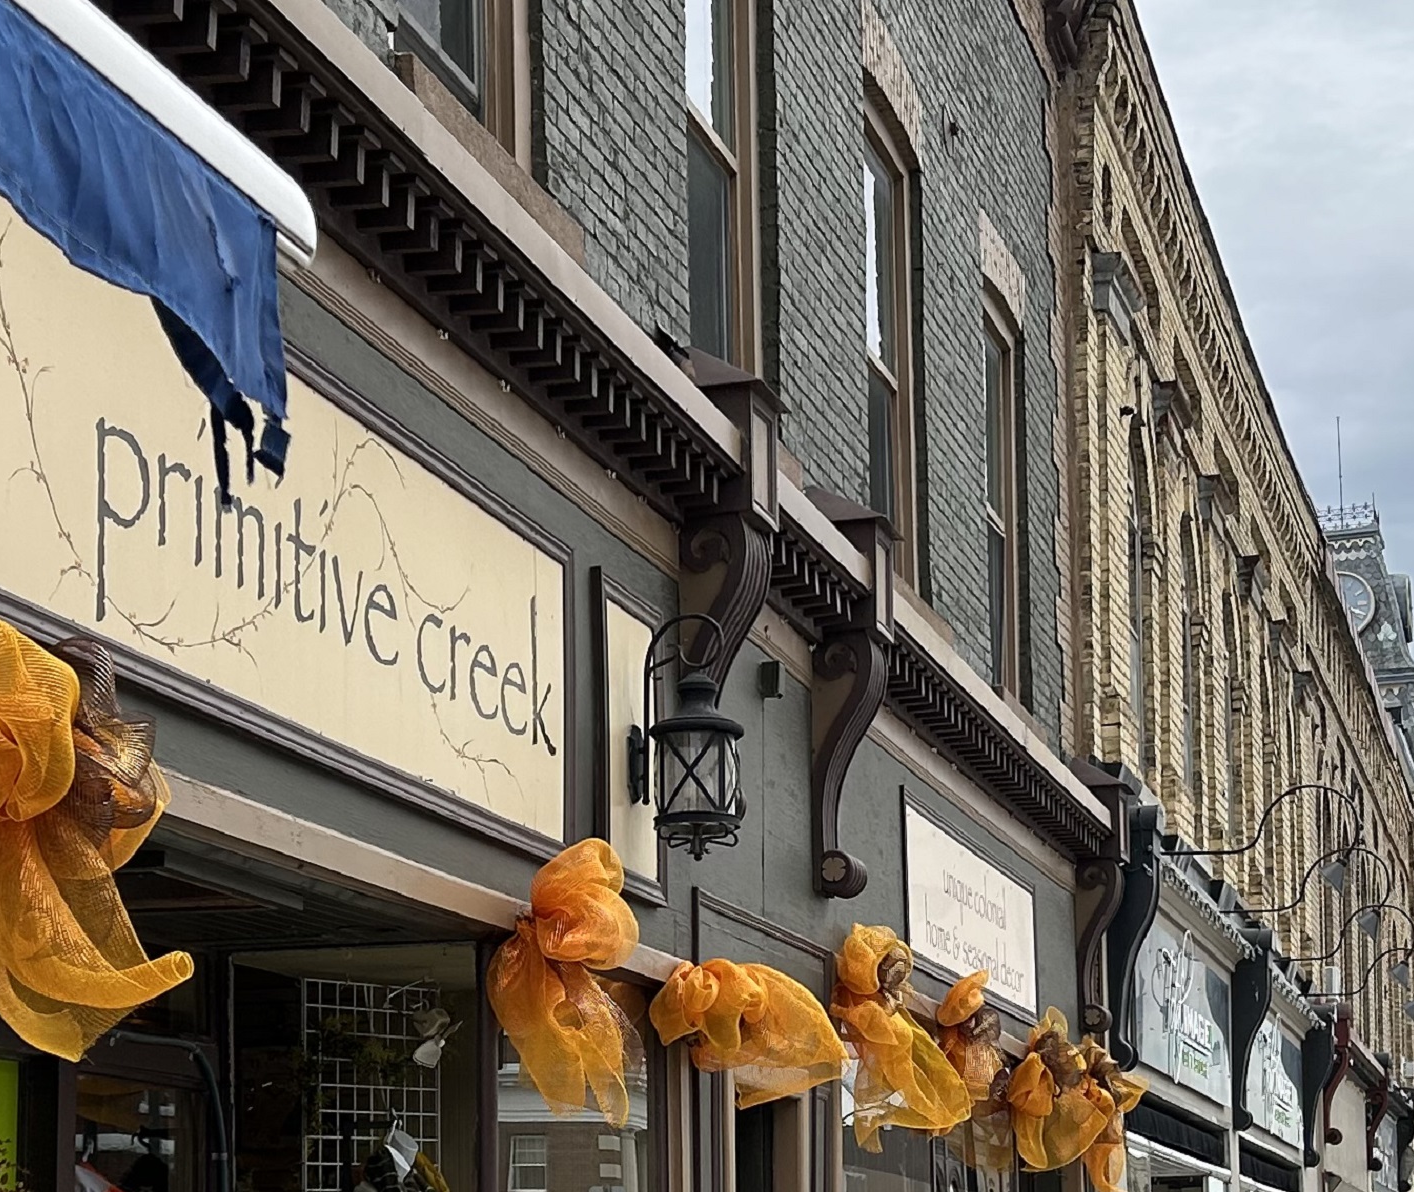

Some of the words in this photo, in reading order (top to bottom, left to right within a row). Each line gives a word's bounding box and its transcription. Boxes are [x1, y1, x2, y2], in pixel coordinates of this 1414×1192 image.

[95, 416, 398, 666] primitive
[417, 597, 556, 755] creek
[924, 892, 951, 954] home
[942, 866, 973, 926] unique
[974, 875, 1006, 930] colonial
